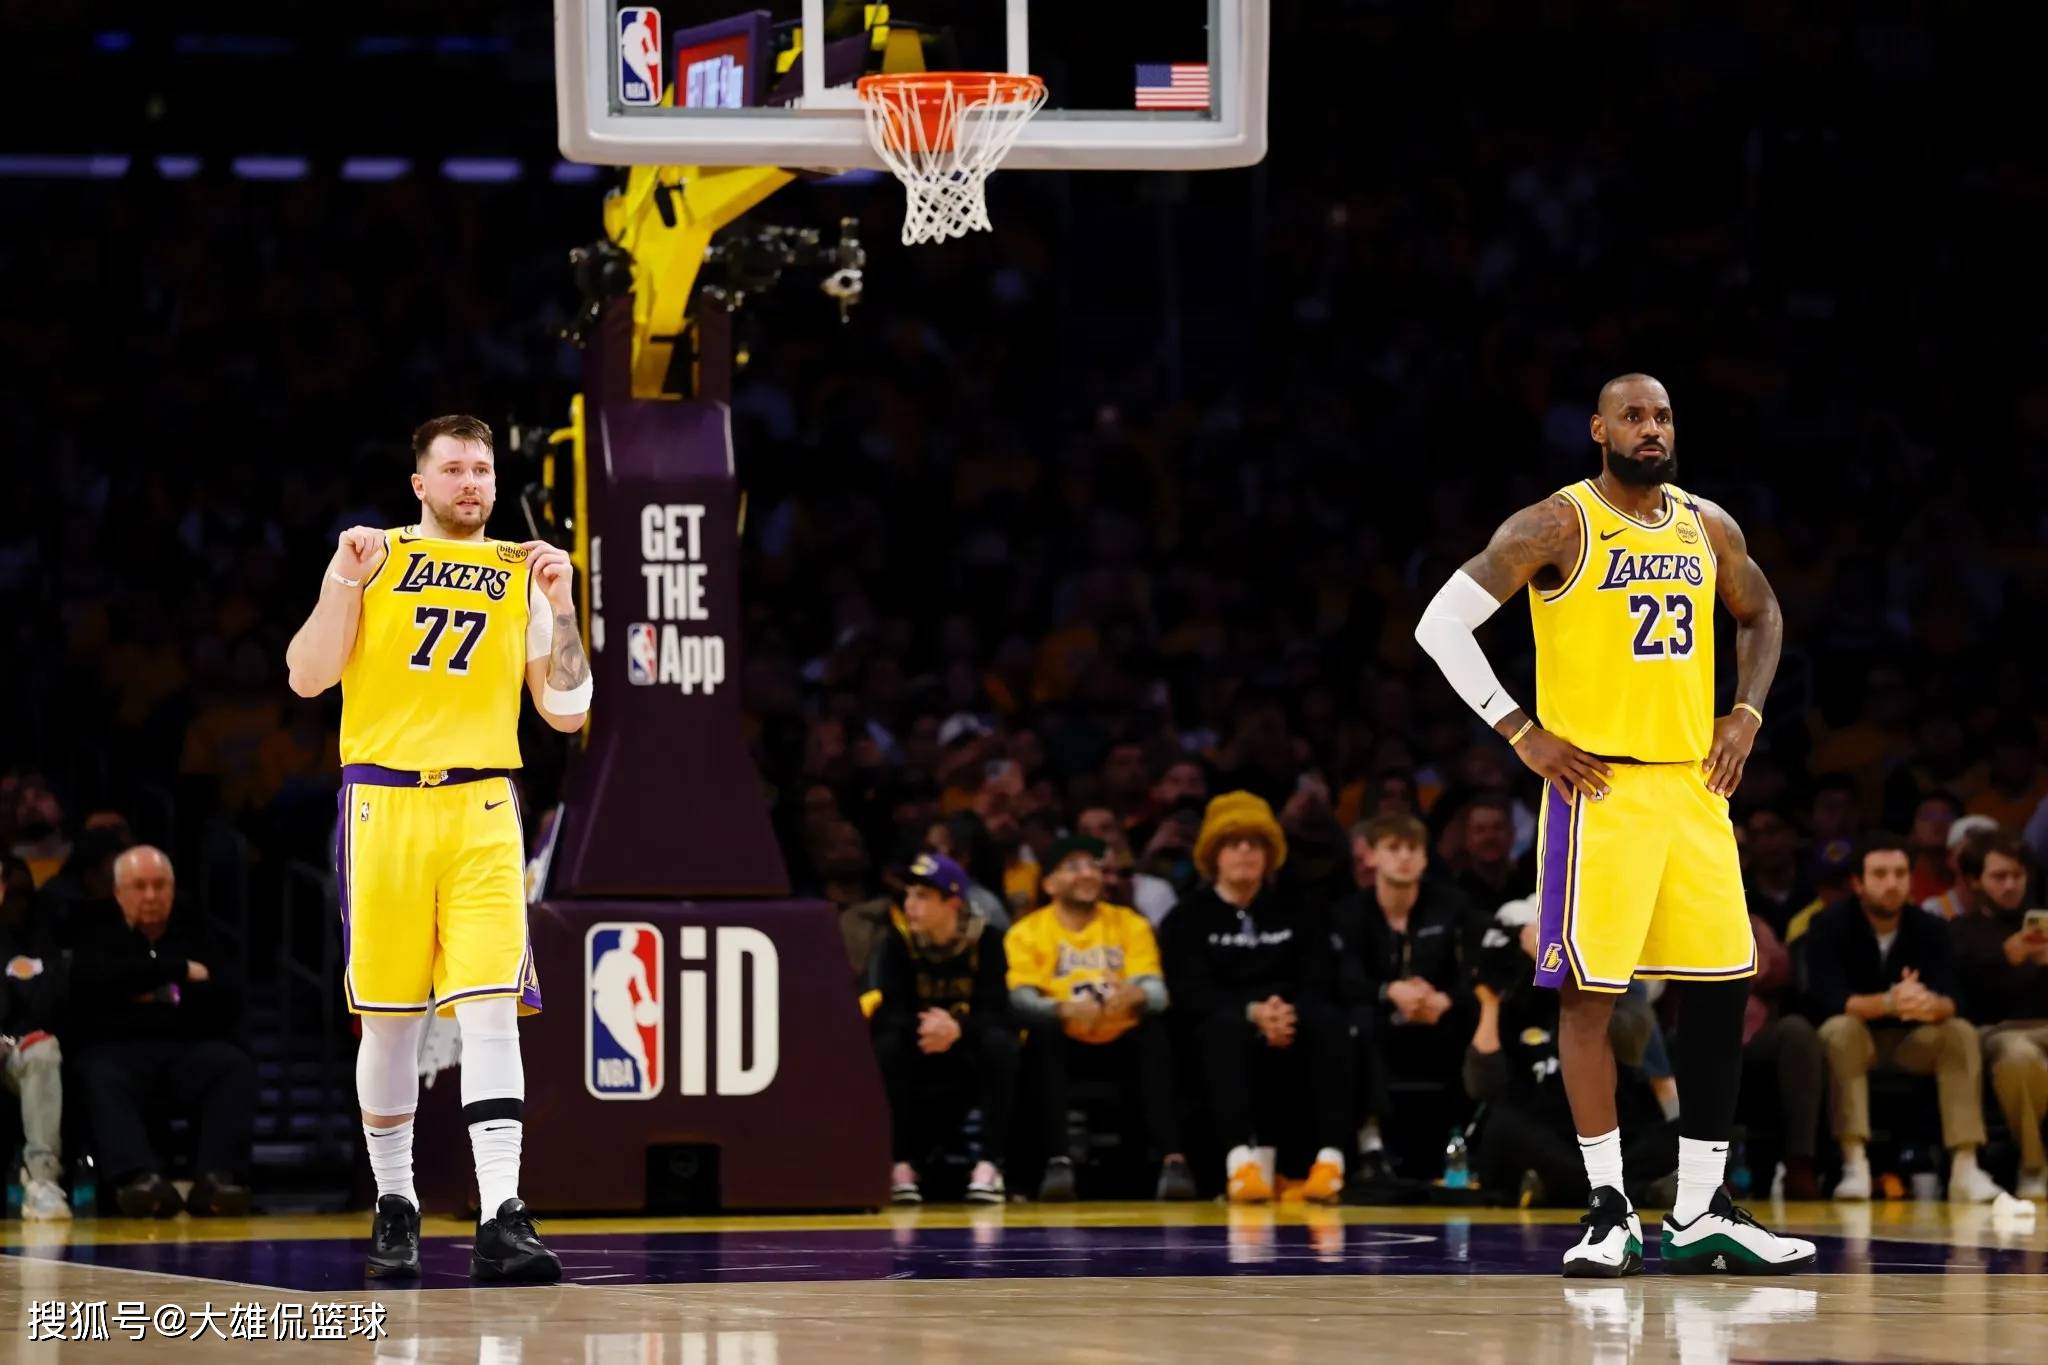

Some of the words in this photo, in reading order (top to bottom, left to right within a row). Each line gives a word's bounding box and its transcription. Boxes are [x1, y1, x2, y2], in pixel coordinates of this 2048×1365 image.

[500, 545, 527, 558] bibigo
[641, 503, 706, 562] GET
[392, 552, 512, 601] LAKERS
[641, 563, 709, 621] THE
[1597, 548, 1703, 587] LAKERS
[409, 605, 488, 673] 77
[1628, 593, 1695, 658] 23
[658, 624, 725, 695] App
[680, 926, 780, 1096] iD
